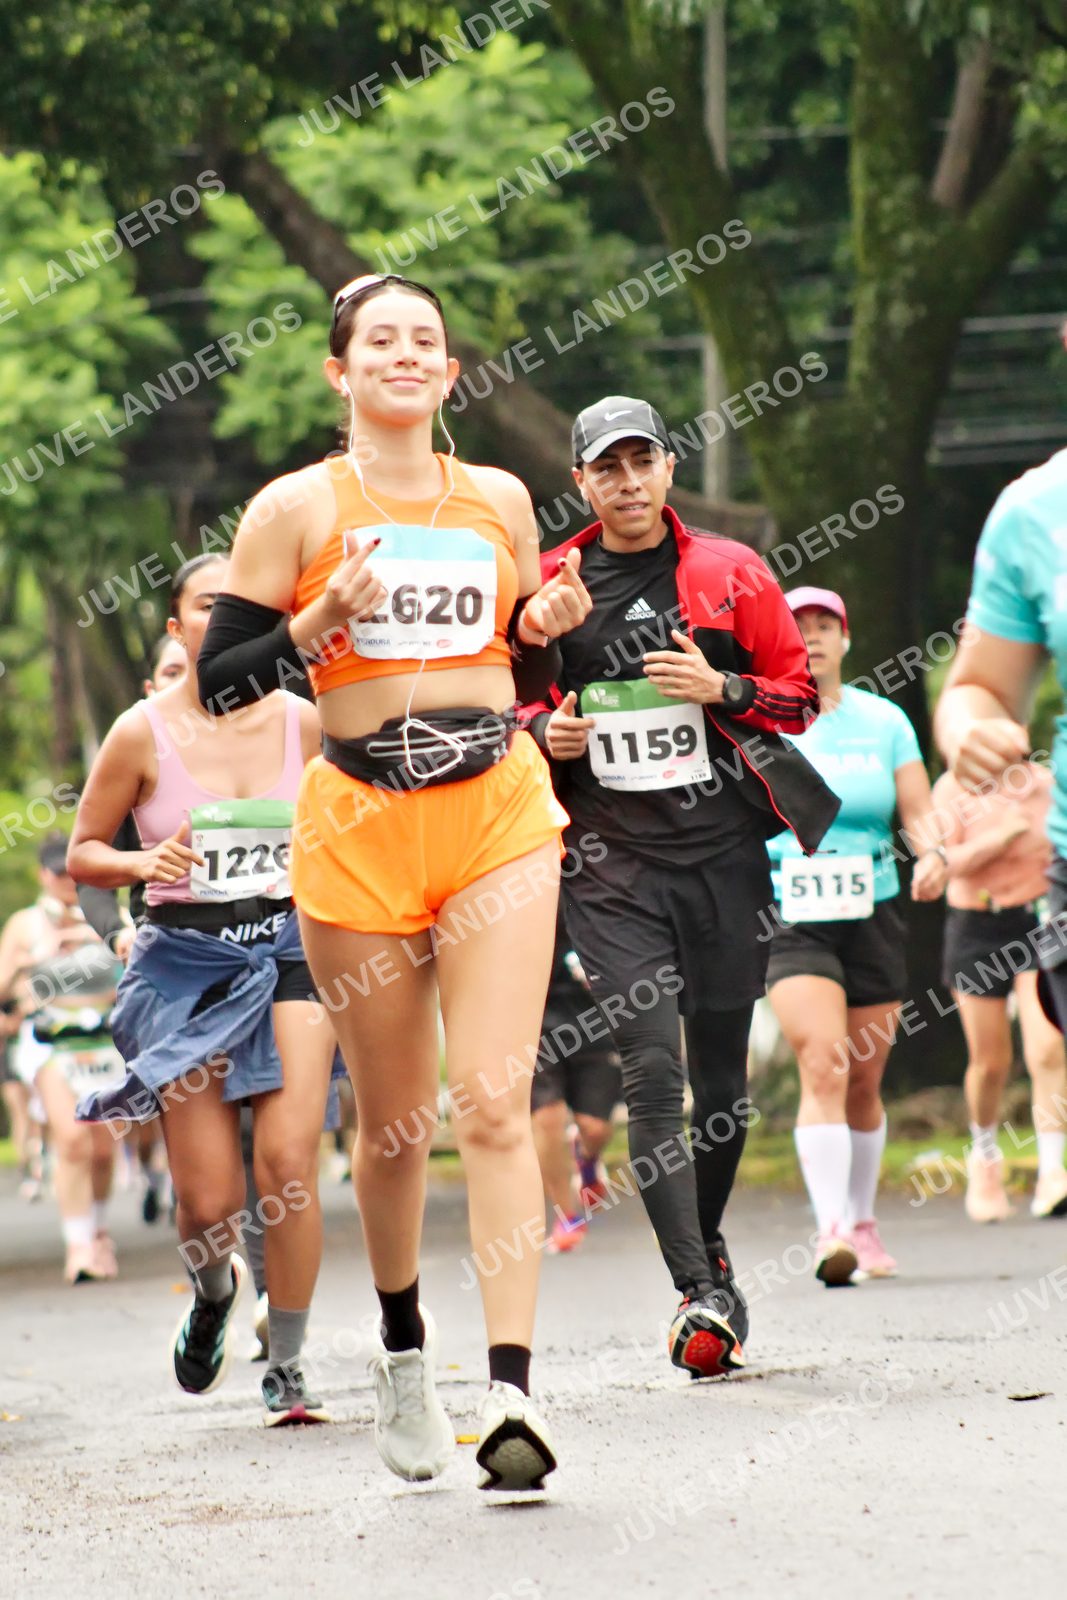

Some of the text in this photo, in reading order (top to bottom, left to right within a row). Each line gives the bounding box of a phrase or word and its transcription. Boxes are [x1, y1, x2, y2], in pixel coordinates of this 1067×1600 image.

[625, 609, 656, 621] adidas
[597, 724, 697, 764] 1159
[791, 872, 865, 898] 5115
[220, 911, 287, 942] NIKE
